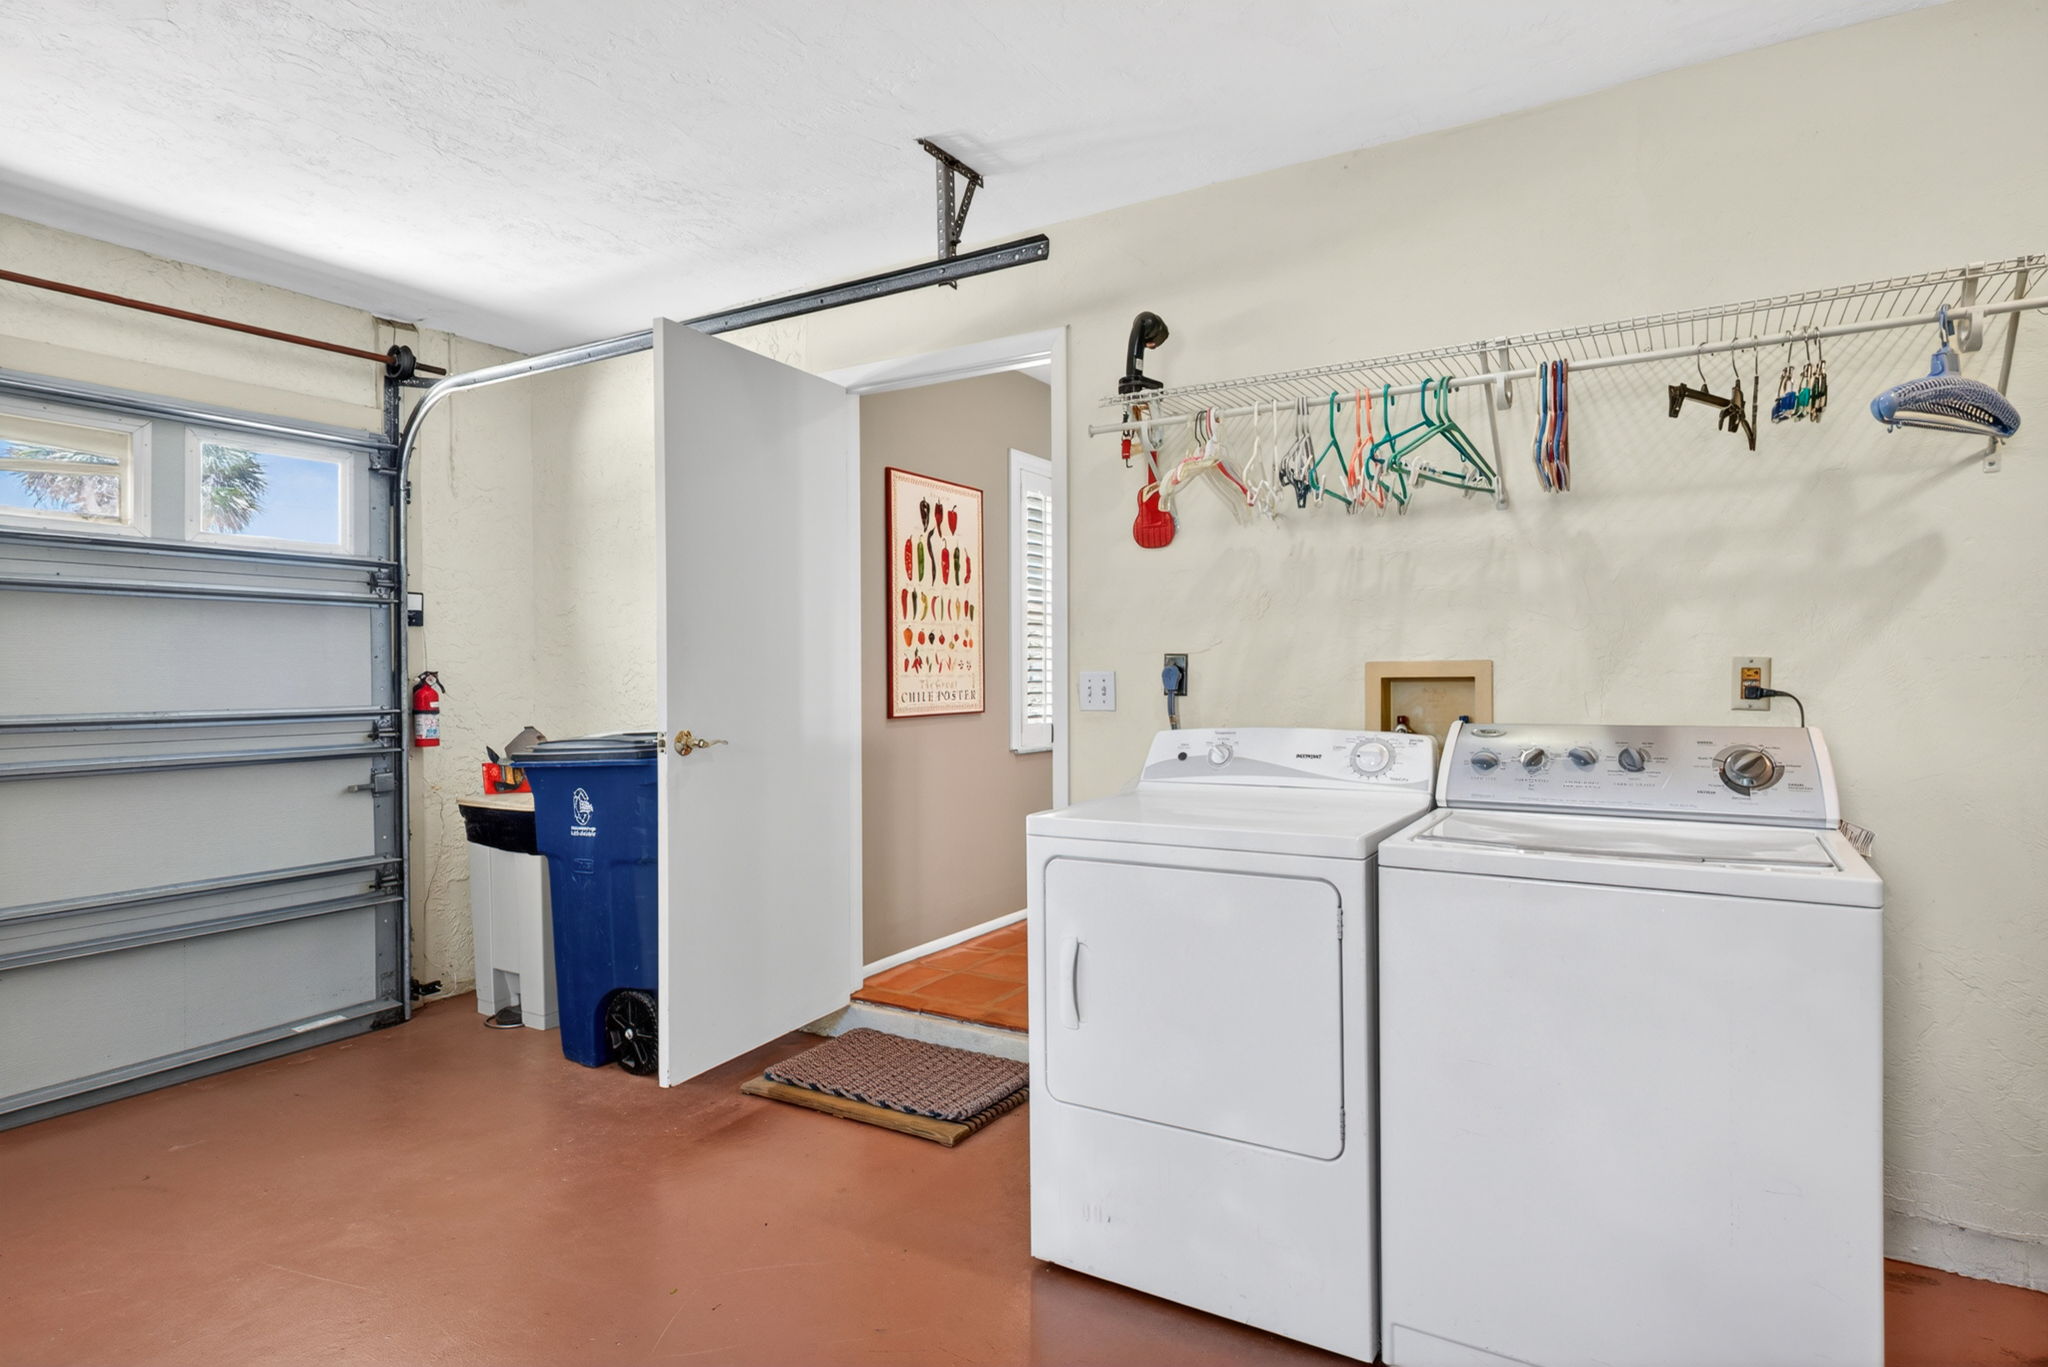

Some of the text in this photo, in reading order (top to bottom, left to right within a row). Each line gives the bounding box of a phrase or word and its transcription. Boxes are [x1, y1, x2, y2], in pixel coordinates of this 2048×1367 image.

[920, 679, 933, 689] The
[901, 690, 976, 703] CHILE POSTER
